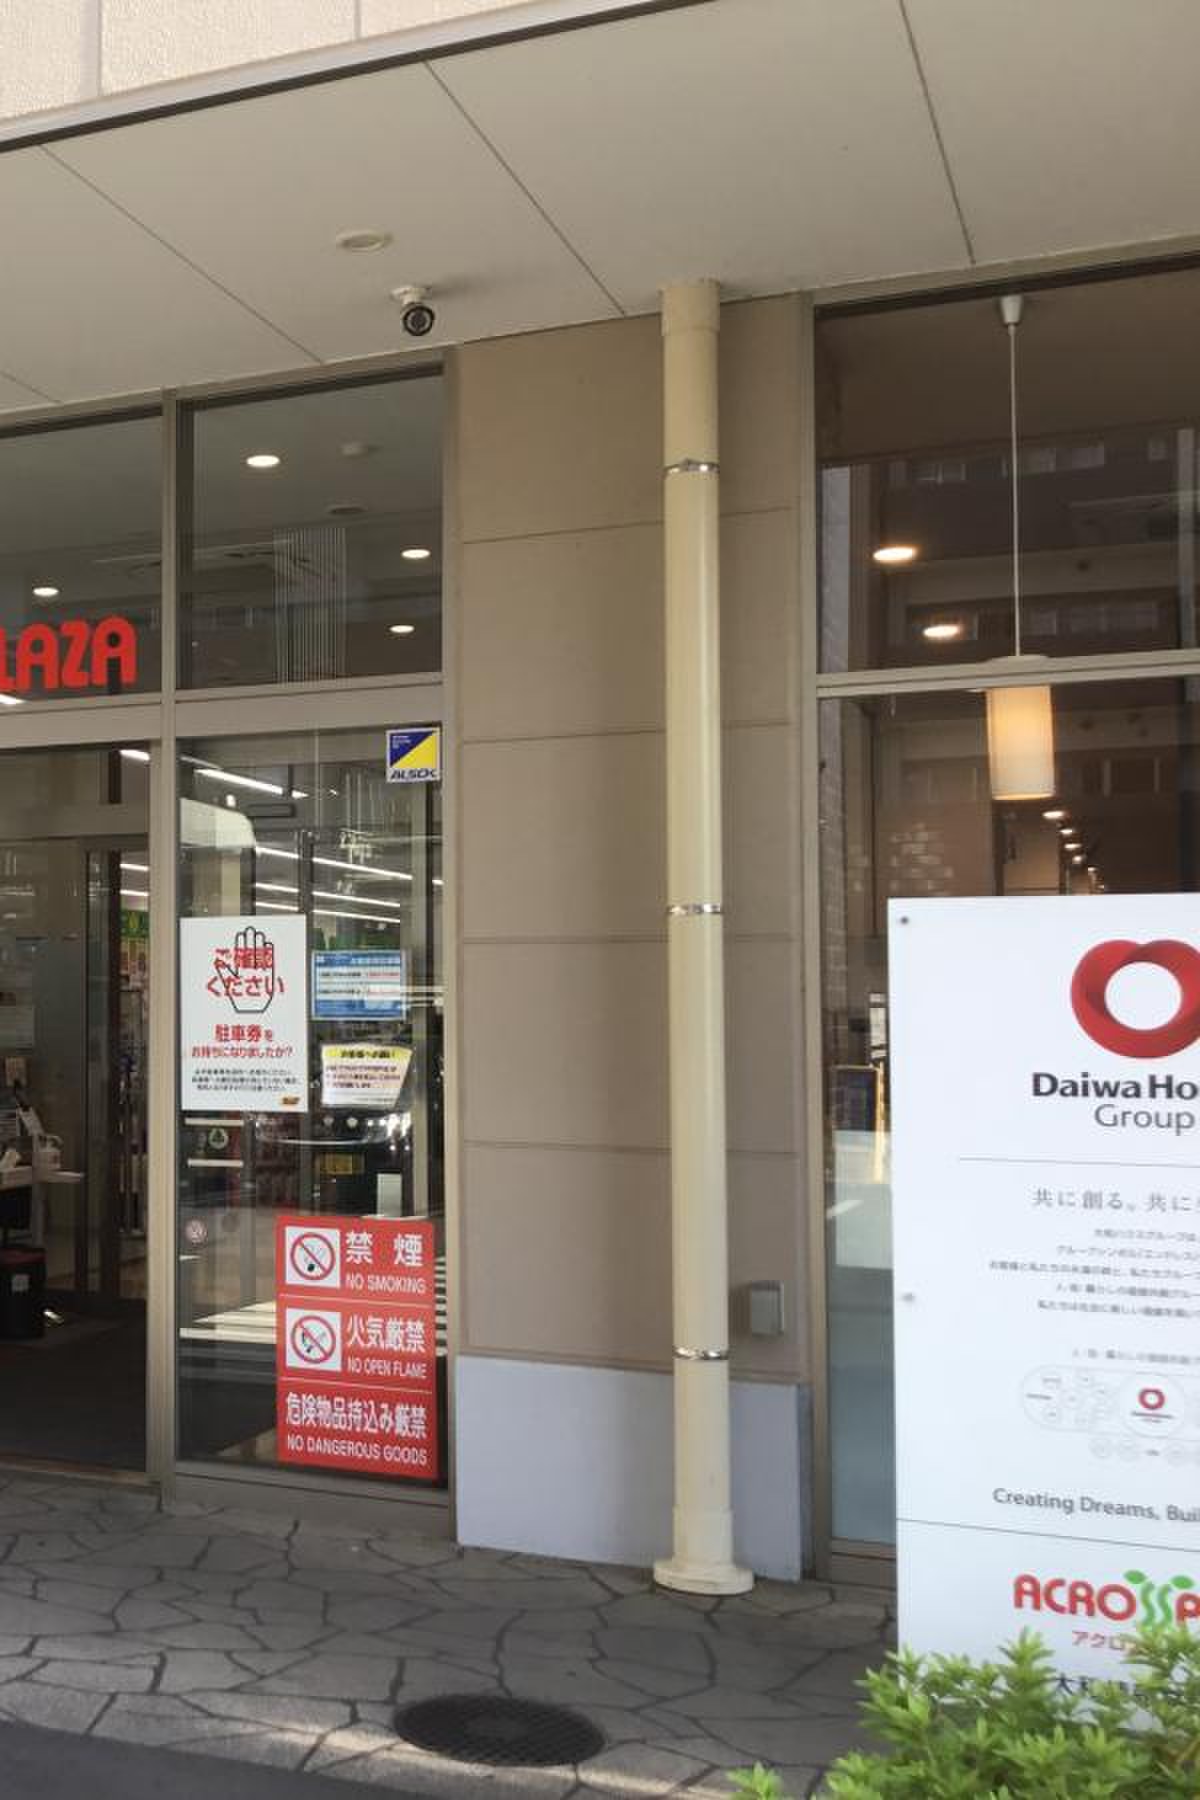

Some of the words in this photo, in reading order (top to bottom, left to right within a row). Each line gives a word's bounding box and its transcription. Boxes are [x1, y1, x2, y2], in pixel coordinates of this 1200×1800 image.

[213, 947, 273, 970] ご確認
[207, 976, 285, 997] ください
[1031, 1071, 1142, 1098] Daiwa
[1094, 1103, 1196, 1137] Group
[345, 1272, 364, 1290] NO
[367, 1274, 427, 1295] SMOKING
[346, 1314, 426, 1353] 火気厳禁
[347, 1355, 362, 1374] NO
[364, 1358, 391, 1376] OPEN
[393, 1360, 427, 1379] FLAME
[286, 1391, 427, 1439] 危険物品持込み厳禁
[287, 1433, 305, 1451] NO
[307, 1436, 381, 1460] DANGEROUS
[383, 1444, 428, 1466] GOODS
[992, 1487, 1075, 1515] Creating
